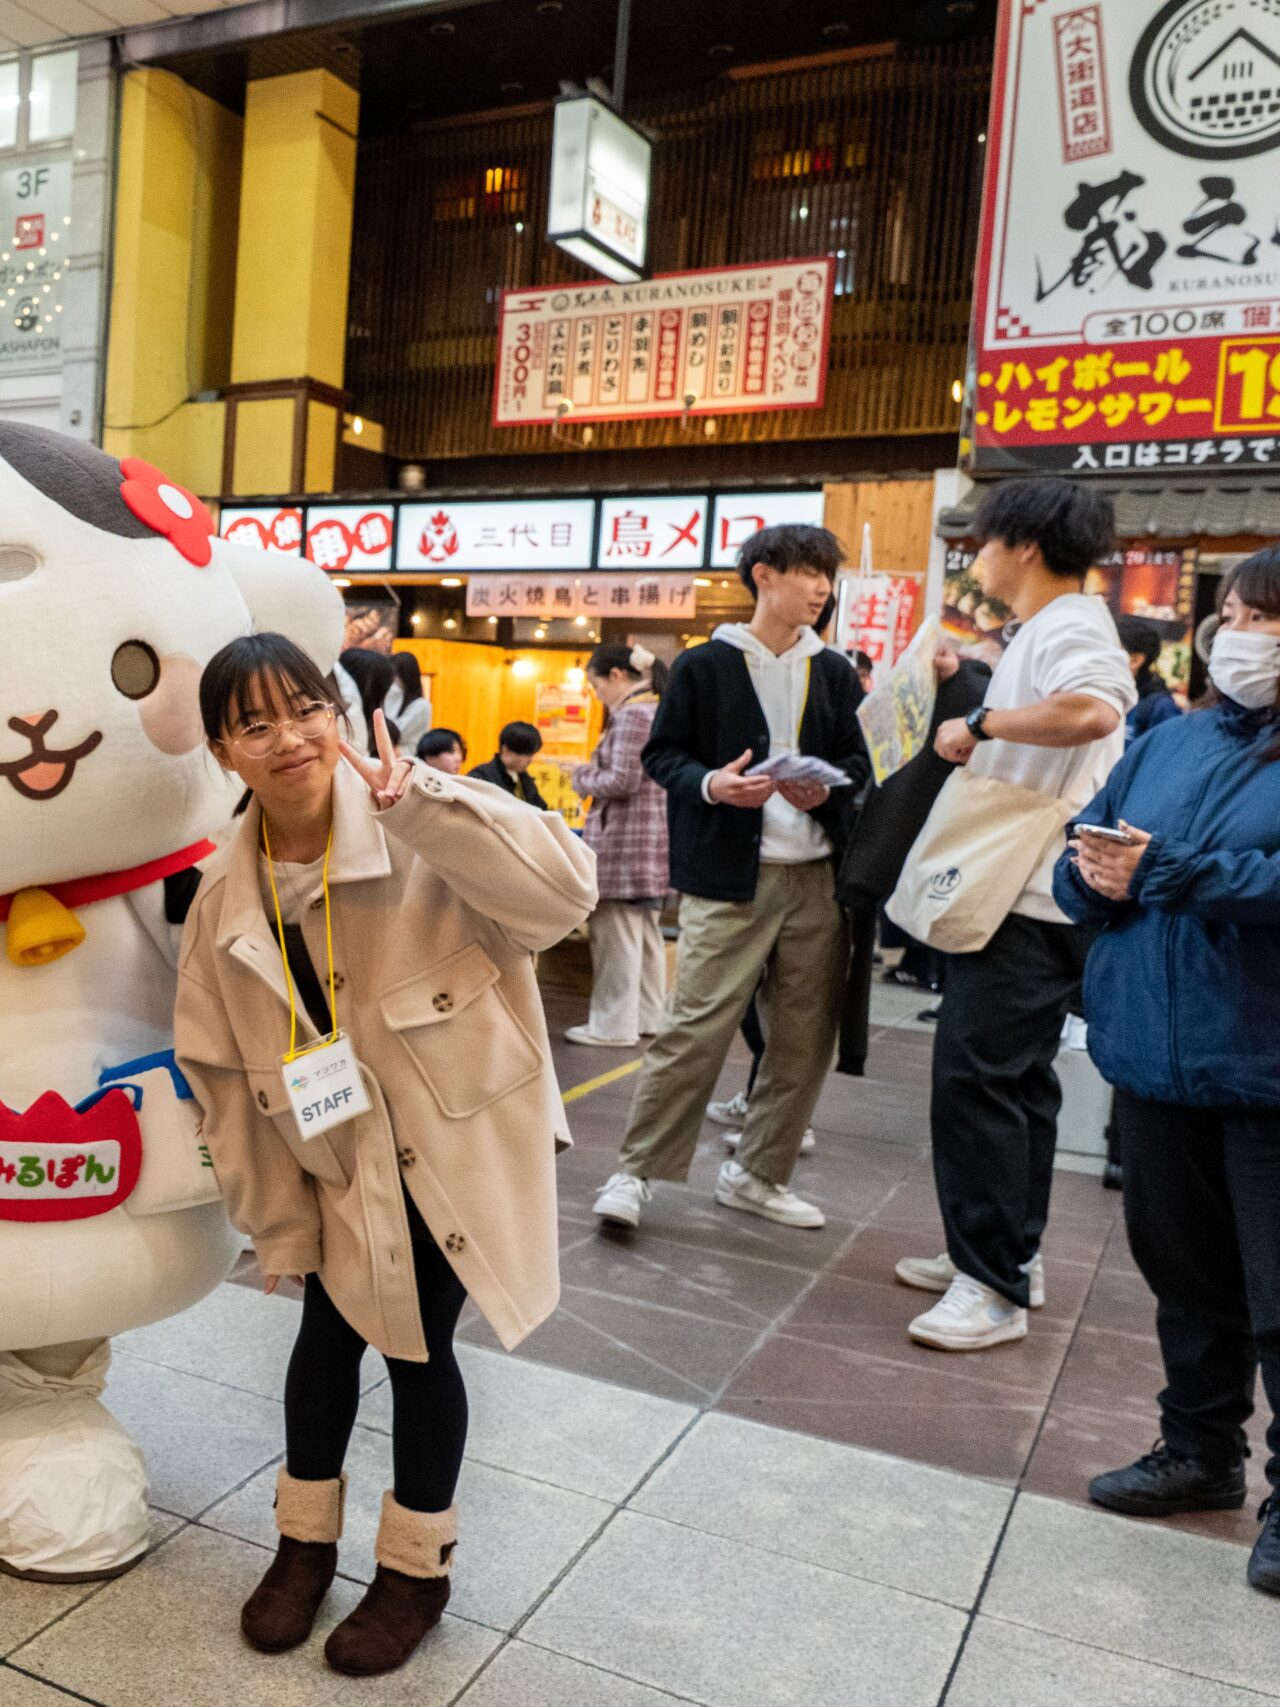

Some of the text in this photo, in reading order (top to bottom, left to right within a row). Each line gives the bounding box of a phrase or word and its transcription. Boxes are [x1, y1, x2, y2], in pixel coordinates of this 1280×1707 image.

[1067, 33, 1098, 137] 大街道店
[16, 168, 50, 199] 3F
[1035, 169, 1280, 303] 蔵之
[621, 276, 758, 304] KURANOSUKE
[1101, 304, 1280, 339] 全100席 個
[1073, 438, 1280, 471] 入口はコチラで
[474, 522, 573, 549] 三代目
[470, 584, 693, 608] 炭火焼鳥と串揚げ
[301, 1086, 354, 1123] STAFF
